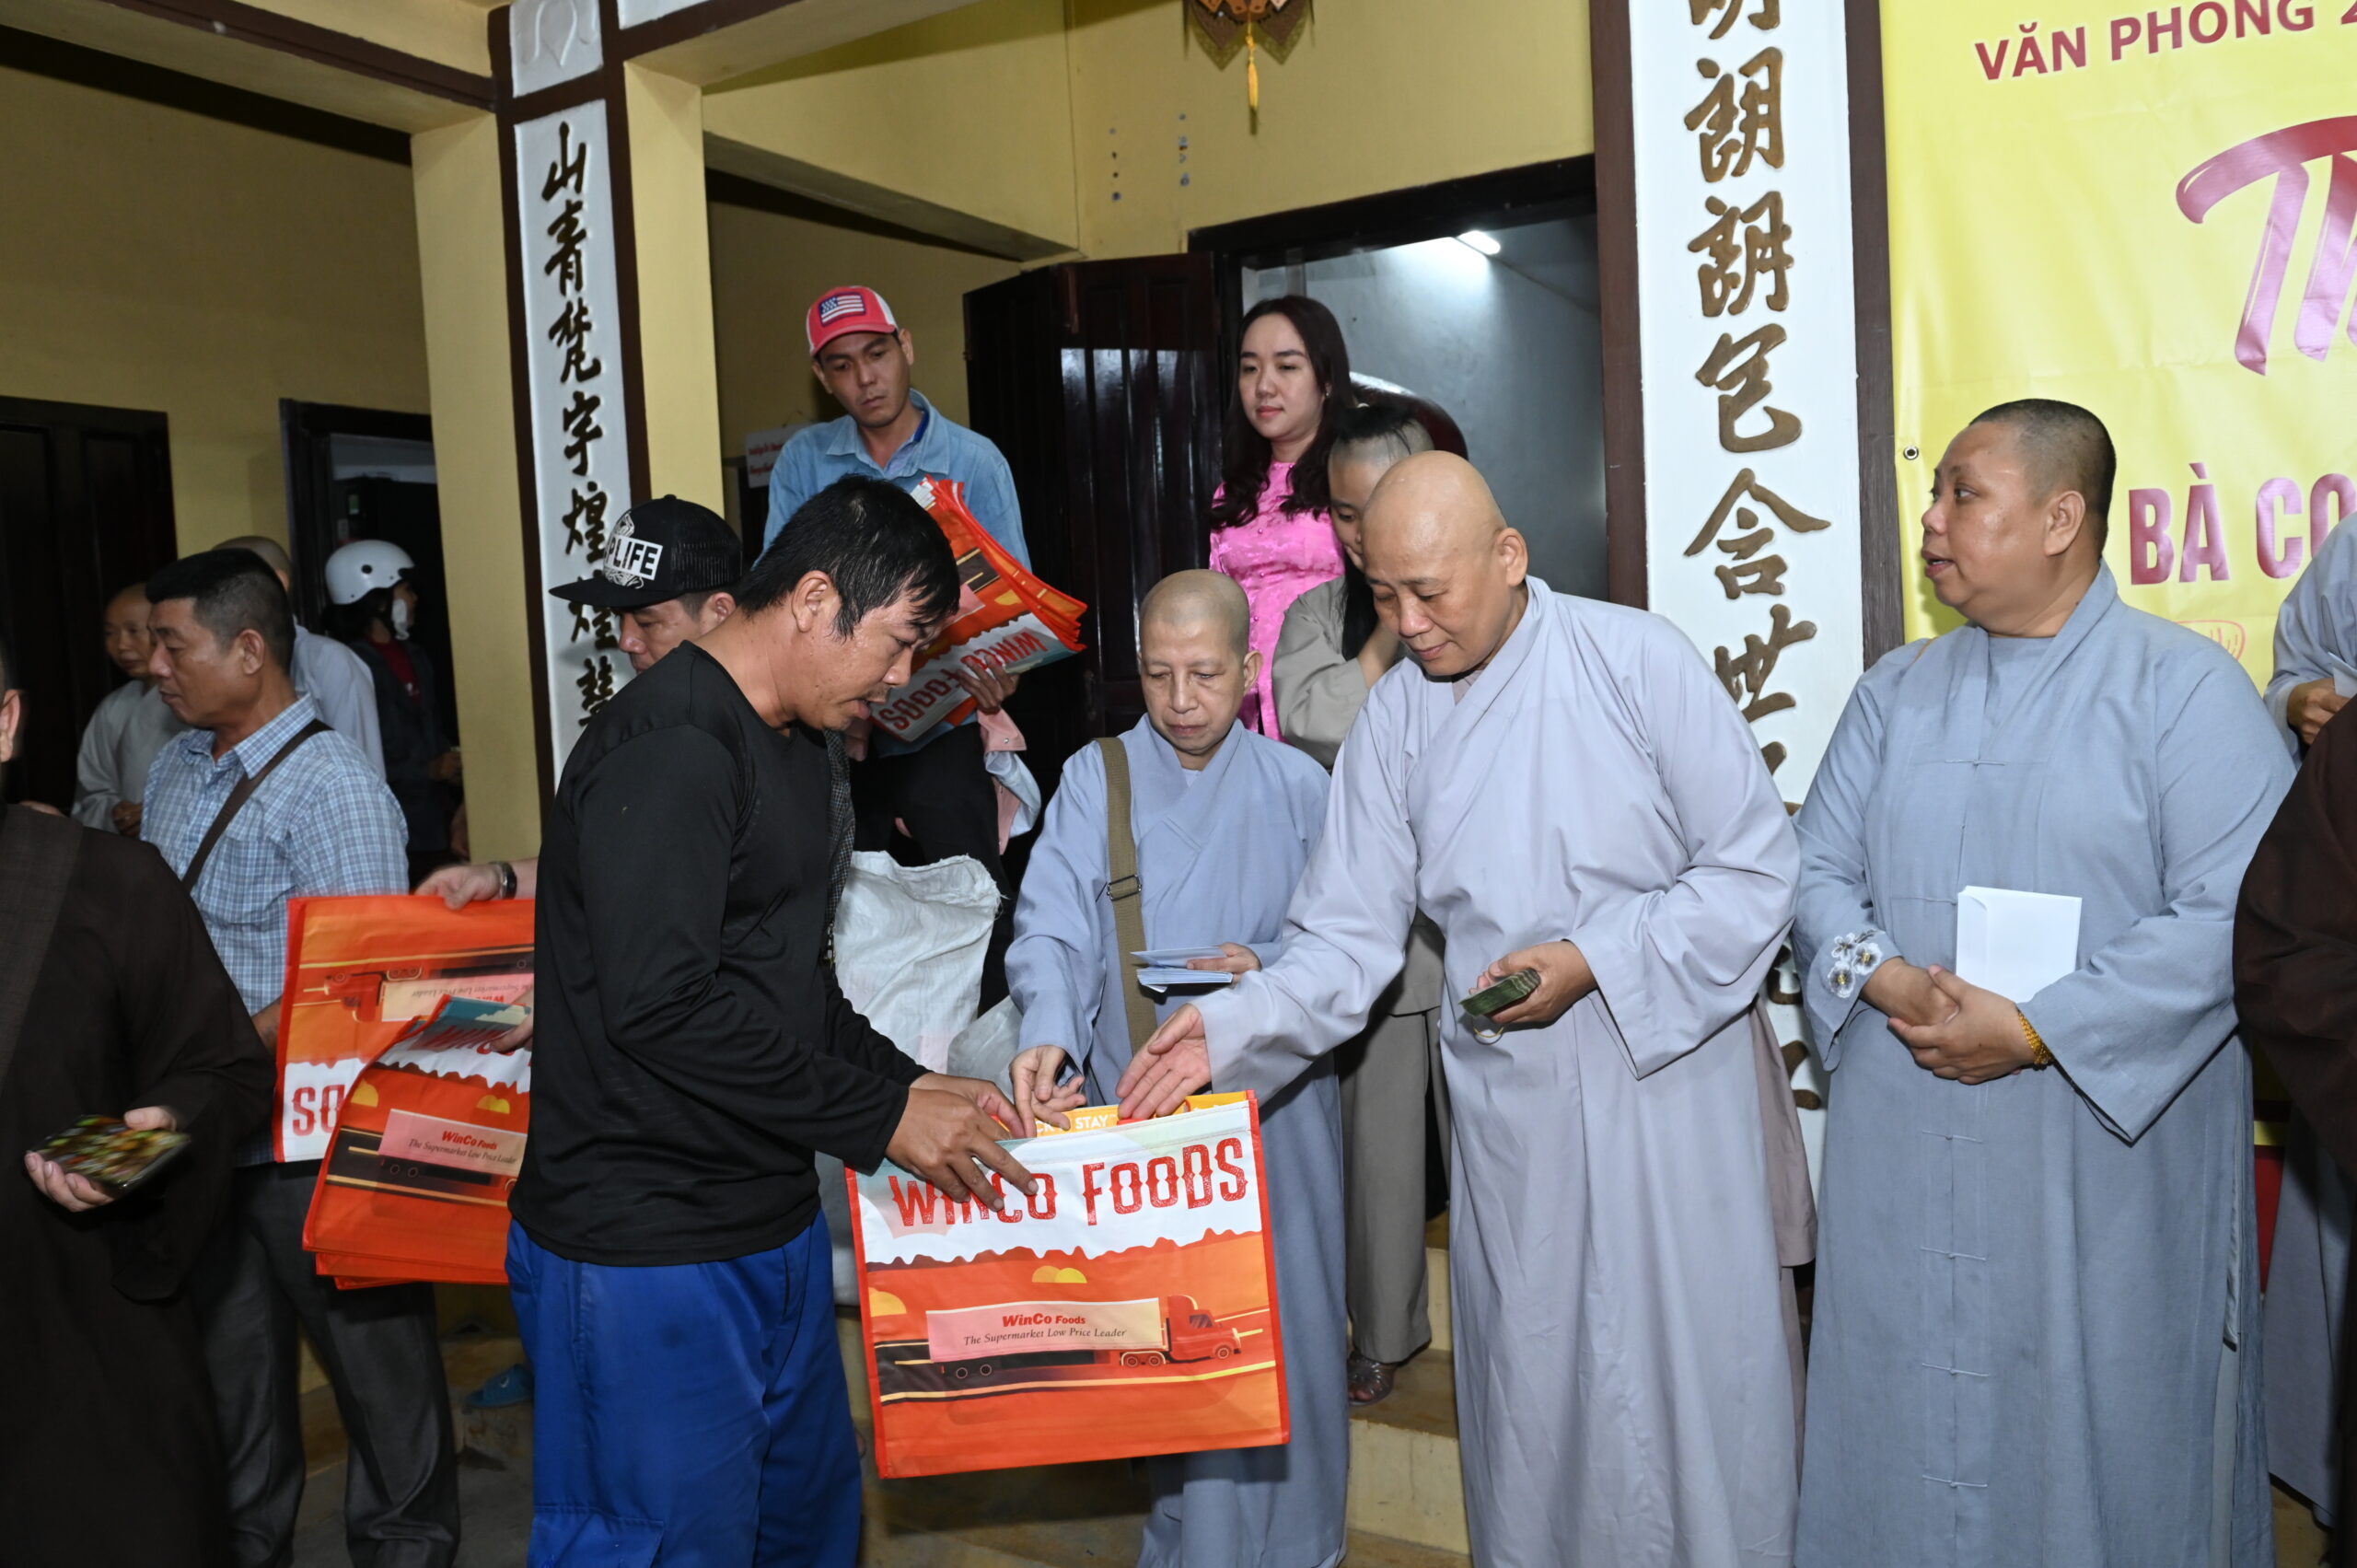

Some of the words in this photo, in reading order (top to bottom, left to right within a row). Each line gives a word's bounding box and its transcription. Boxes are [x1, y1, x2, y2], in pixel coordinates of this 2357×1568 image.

[1974, 21, 2087, 81] VĂN
[2128, 462, 2231, 586] BÀ
[604, 537, 659, 576] PLIFE
[408, 1138, 422, 1148] The
[442, 1130, 477, 1146] WinCo
[1082, 1136, 1249, 1226] FOODS
[1002, 1312, 1052, 1327] WinCo
[1055, 1315, 1086, 1325] Foods
[963, 1335, 981, 1346] The
[984, 1329, 1045, 1344] Supermarket
[1047, 1328, 1066, 1337] Low
[1069, 1327, 1091, 1337] Price
[1094, 1327, 1128, 1338] Leader
